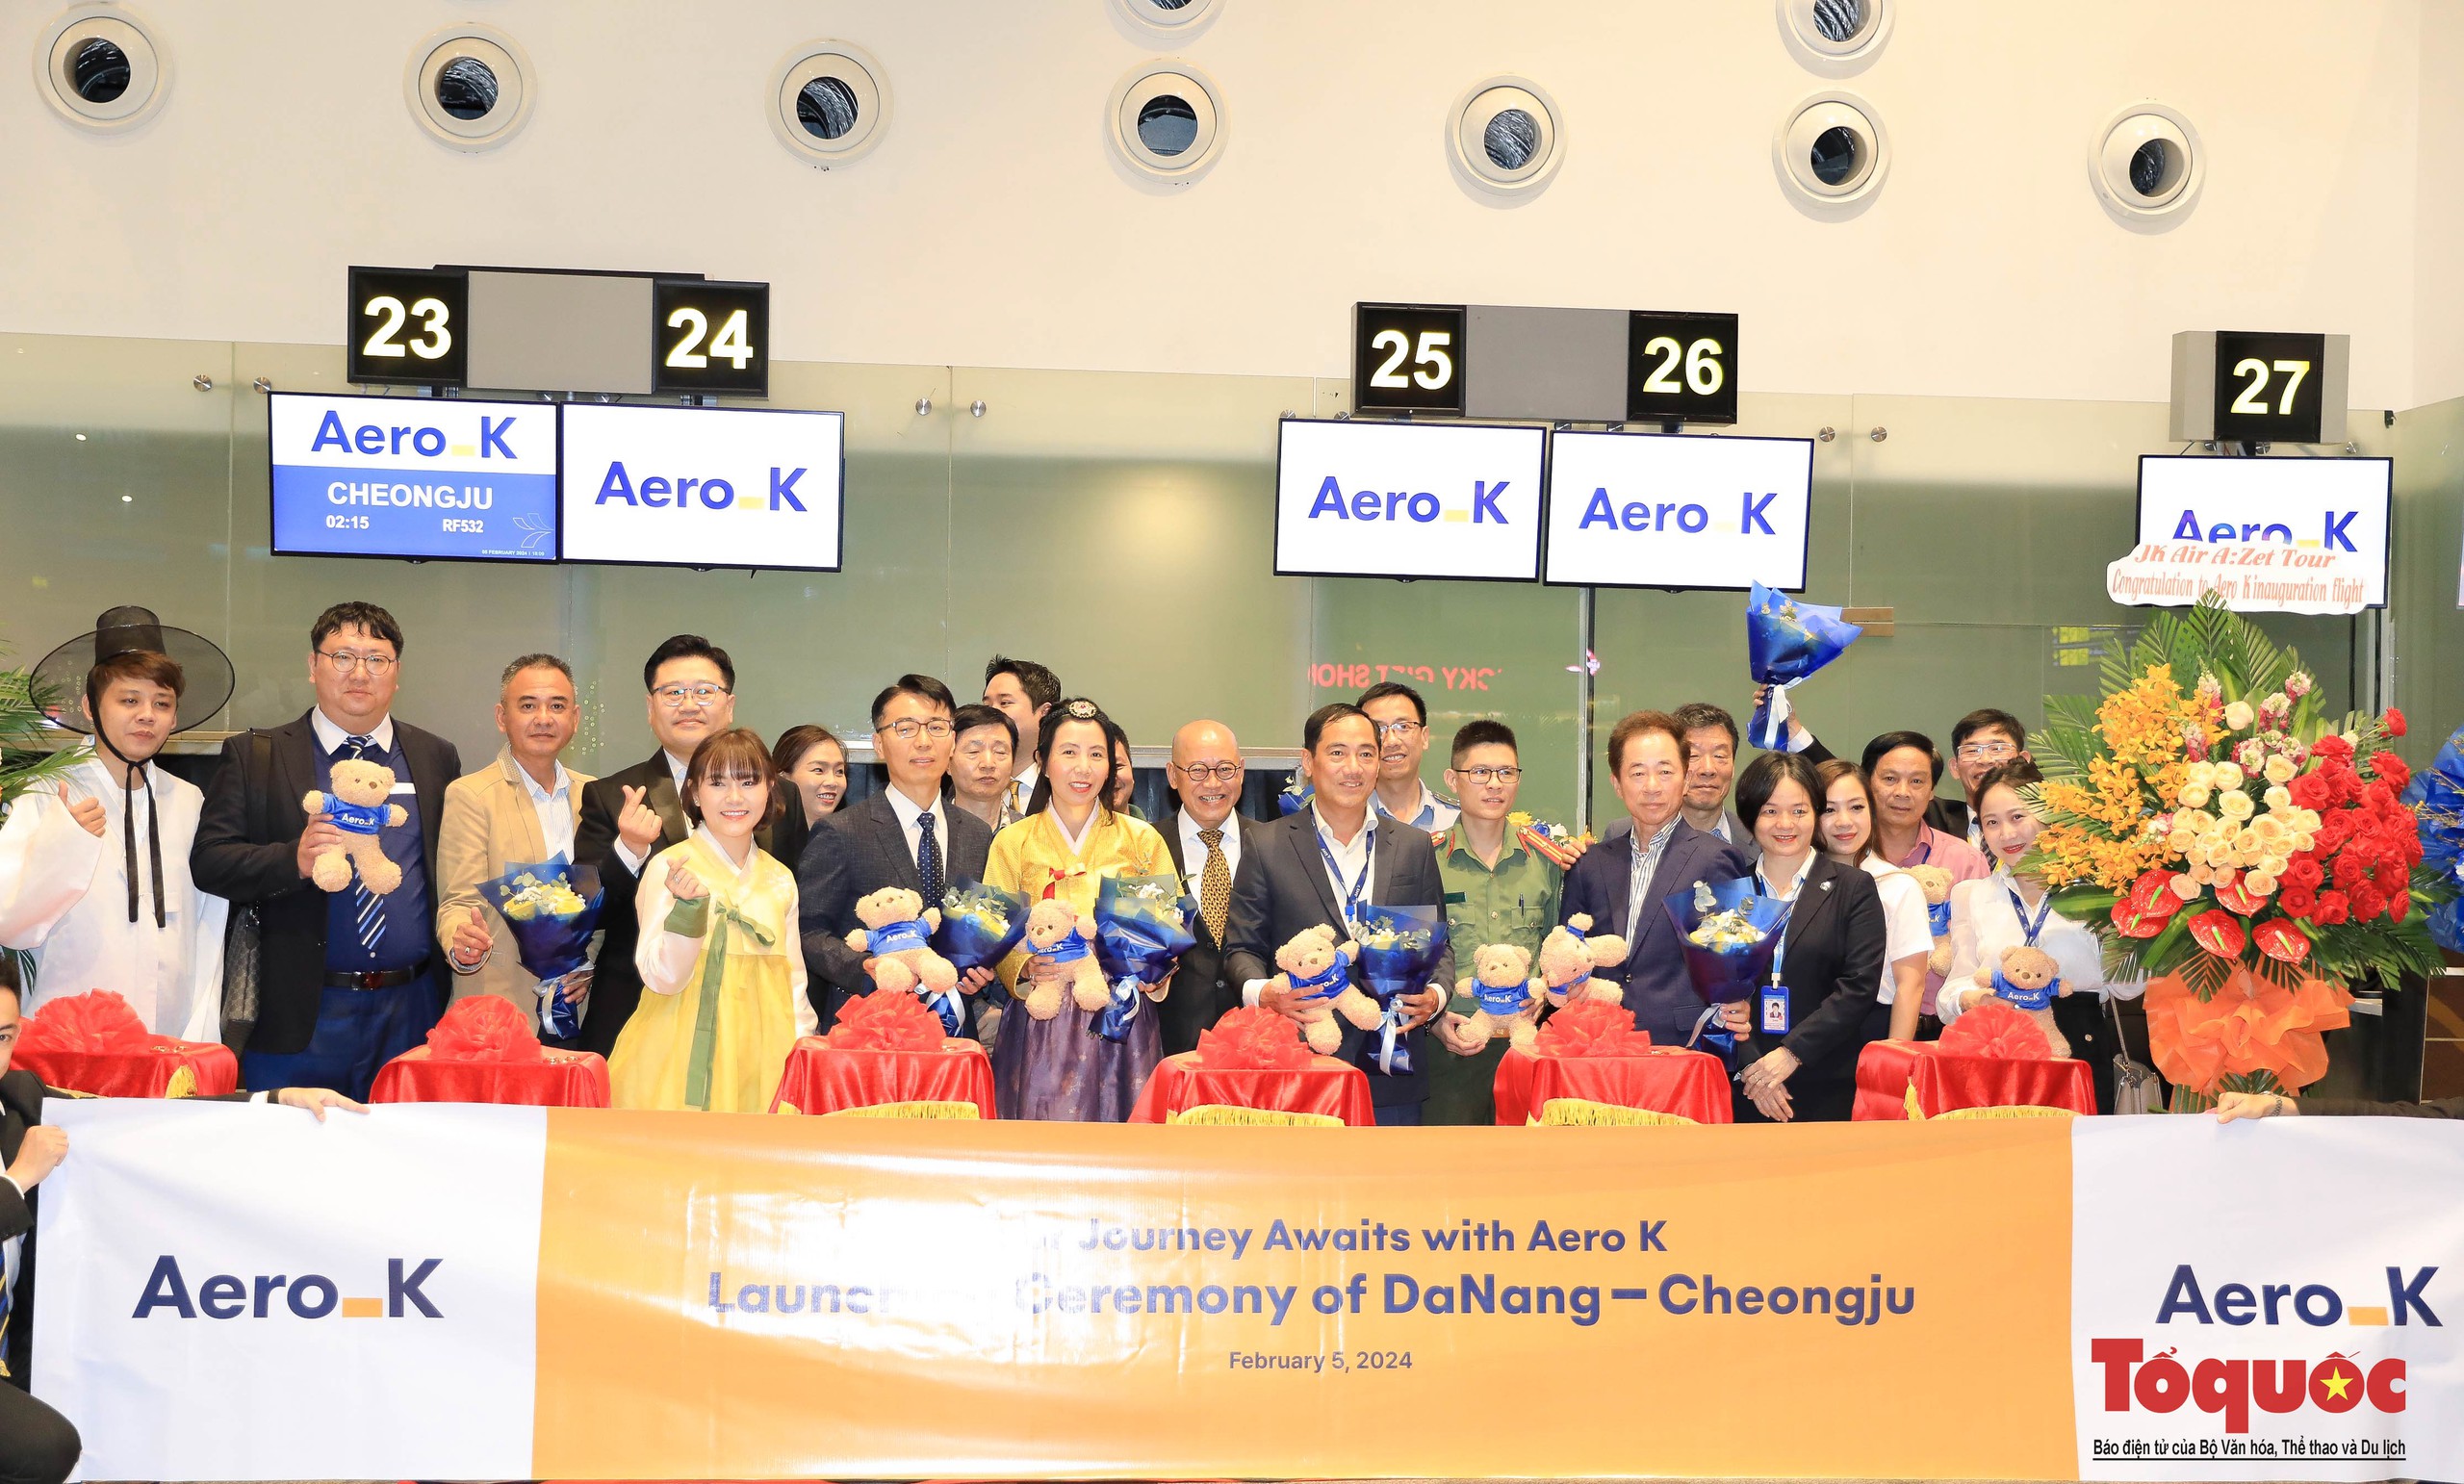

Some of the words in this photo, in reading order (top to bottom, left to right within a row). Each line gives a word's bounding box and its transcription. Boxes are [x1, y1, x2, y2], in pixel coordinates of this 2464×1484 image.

[363, 296, 451, 359] 23
[666, 308, 754, 370] 24
[1370, 330, 1452, 390] 25
[1642, 337, 1724, 396] 26
[2230, 358, 2310, 415] 27
[327, 481, 493, 510] CHEONGJU
[325, 515, 370, 529] 02:15
[442, 519, 484, 533] RF532
[2135, 544, 2168, 563] JK
[2170, 545, 2208, 564] Air
[2281, 549, 2336, 568] Tour
[2112, 568, 2194, 601] Congratulation
[2198, 575, 2209, 597] to
[2213, 574, 2238, 600] Aero
[2243, 575, 2251, 600] K
[2253, 575, 2327, 607] inauguration
[2332, 577, 2365, 609] flight
[1078, 1218, 1252, 1261] Journey
[1263, 1219, 1410, 1251] Awaits
[1422, 1219, 1515, 1251] with
[1527, 1219, 1626, 1252] Aero
[1639, 1219, 1668, 1251] K
[1015, 1270, 1297, 1326] Ceremony
[1312, 1271, 1368, 1315] of
[1383, 1272, 1601, 1326] DaNang
[1658, 1272, 1915, 1326] Cheongju
[1229, 1350, 1325, 1373] February
[1332, 1351, 1350, 1373] 5,
[1356, 1351, 1413, 1369] 2024
